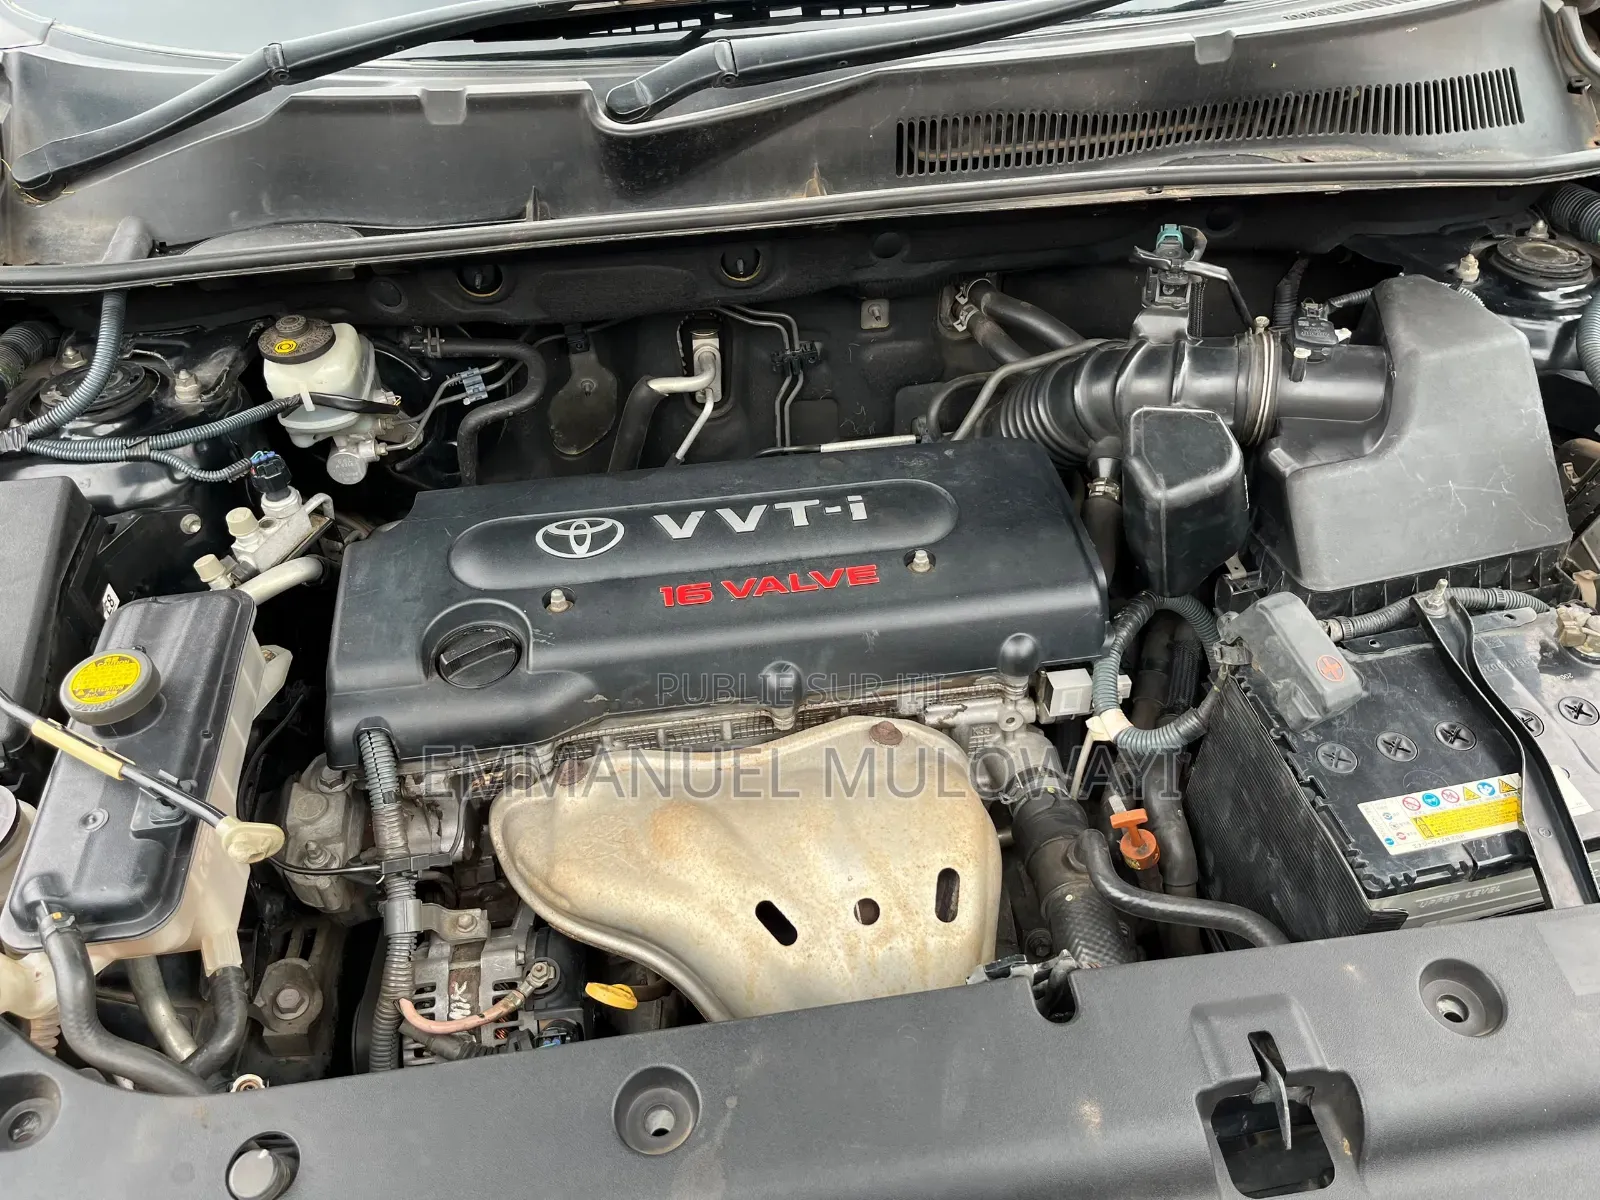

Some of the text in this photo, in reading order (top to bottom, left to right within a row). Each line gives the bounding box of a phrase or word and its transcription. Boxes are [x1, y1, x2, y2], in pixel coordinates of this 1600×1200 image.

[651, 495, 868, 540] VVT-i
[659, 564, 880, 607] 16 VALVE
[1418, 885, 1502, 909] UPPER LEVEL
